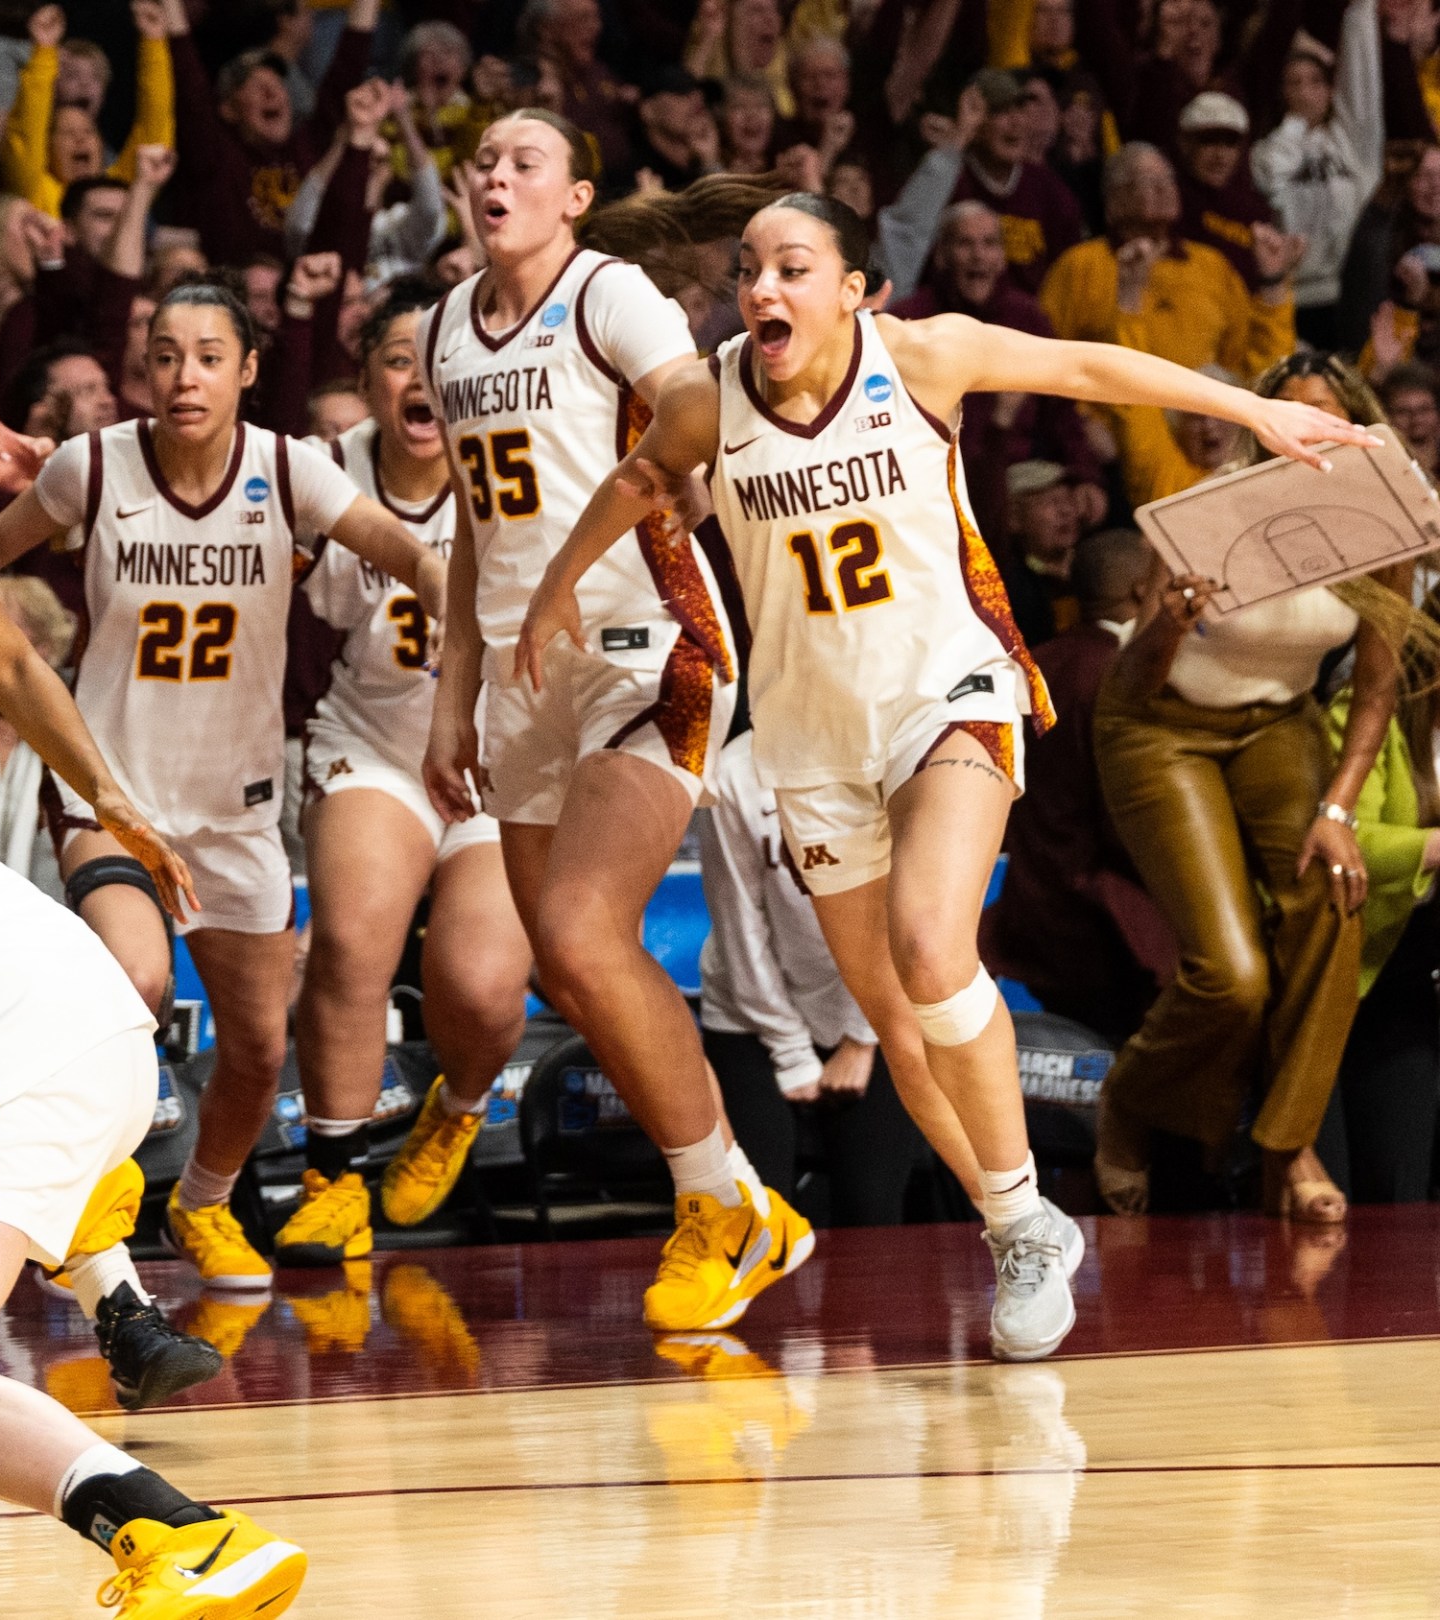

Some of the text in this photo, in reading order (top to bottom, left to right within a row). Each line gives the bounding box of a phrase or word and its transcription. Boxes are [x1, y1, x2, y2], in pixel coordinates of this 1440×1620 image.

[440, 366, 553, 425] MINNESOTA
[458, 428, 542, 524] 35
[733, 448, 907, 521] MINNESOTA
[116, 540, 266, 586] MINNESOTA
[786, 518, 895, 616] 12
[136, 602, 238, 683] 22
[803, 842, 841, 870] M
